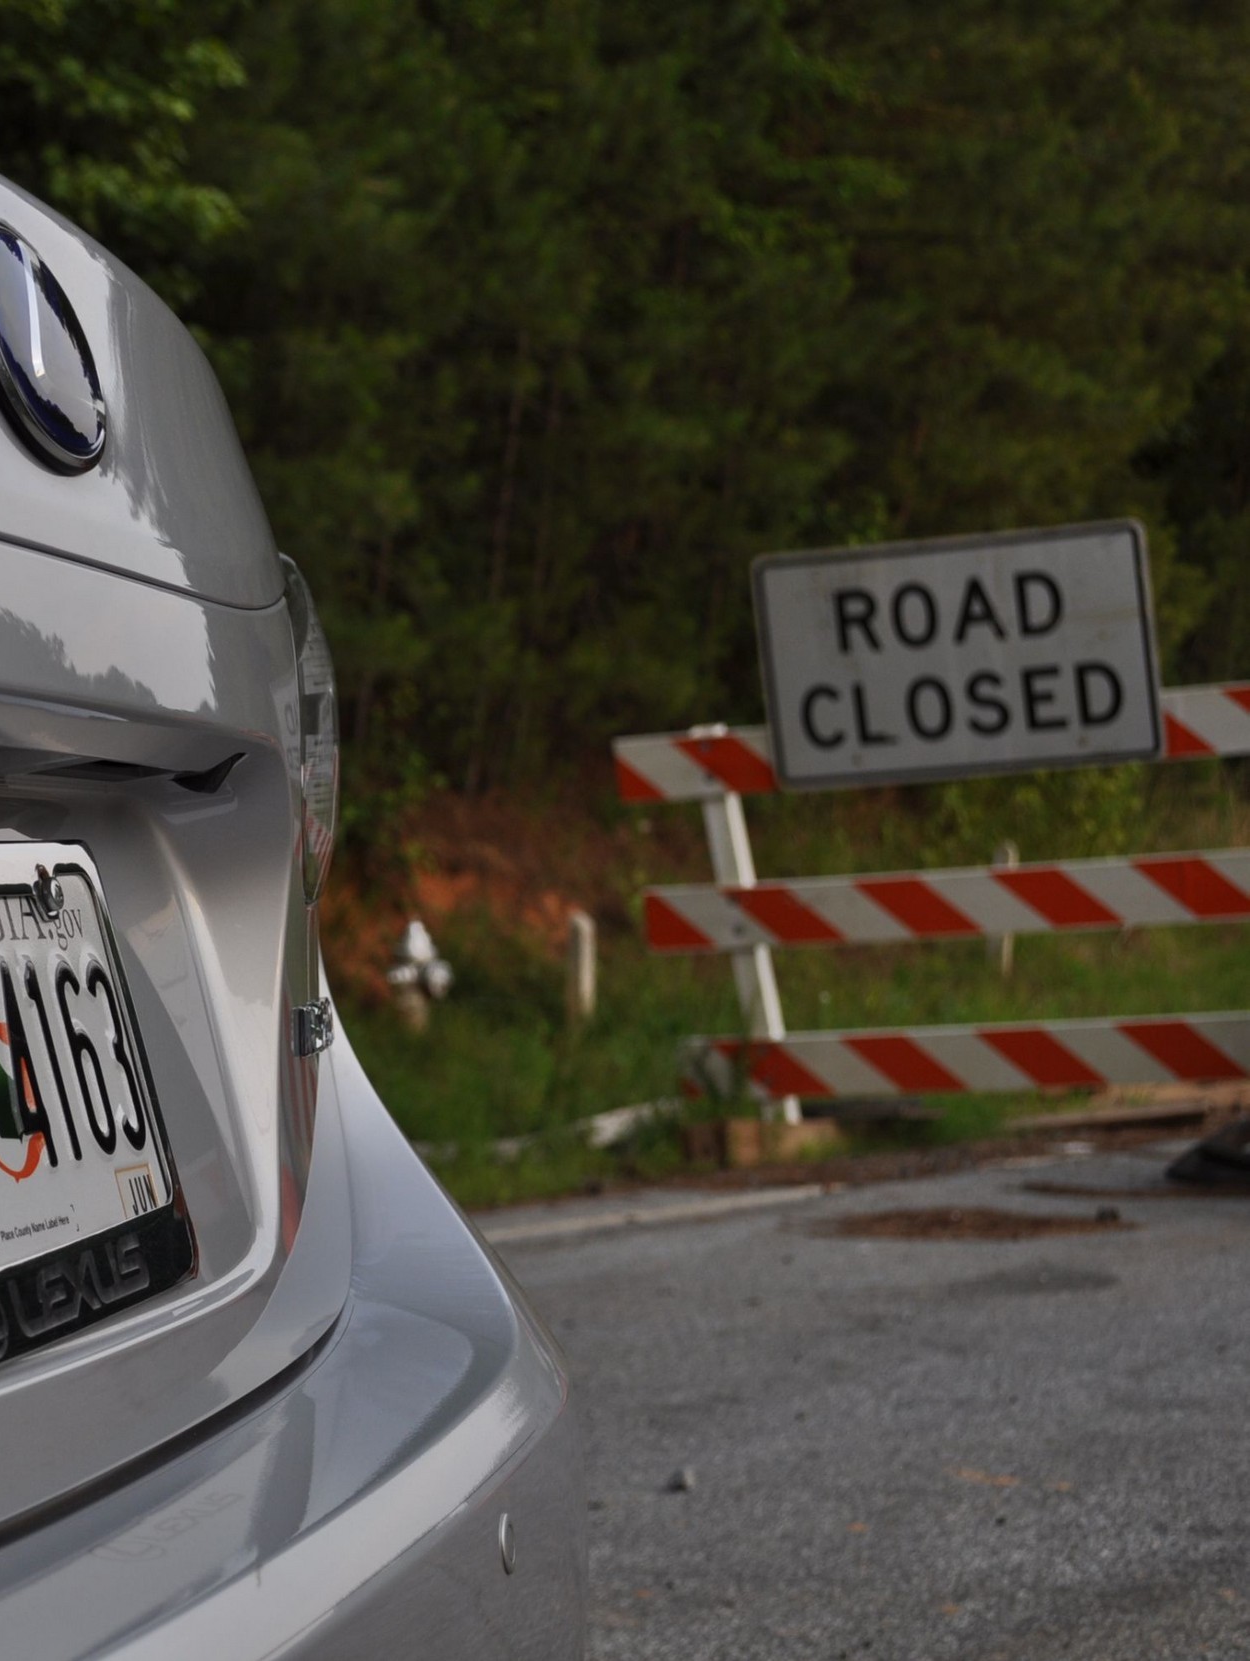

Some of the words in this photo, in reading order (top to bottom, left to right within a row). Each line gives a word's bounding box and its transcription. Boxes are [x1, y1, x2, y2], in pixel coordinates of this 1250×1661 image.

[833, 569, 1064, 654] ROAD
[800, 660, 1125, 750] CLOSED
[0, 959, 146, 1168] 4163
[14, 1226, 32, 1237] County
[31, 1222, 46, 1233] Name
[7, 1232, 150, 1338] LEXUS
